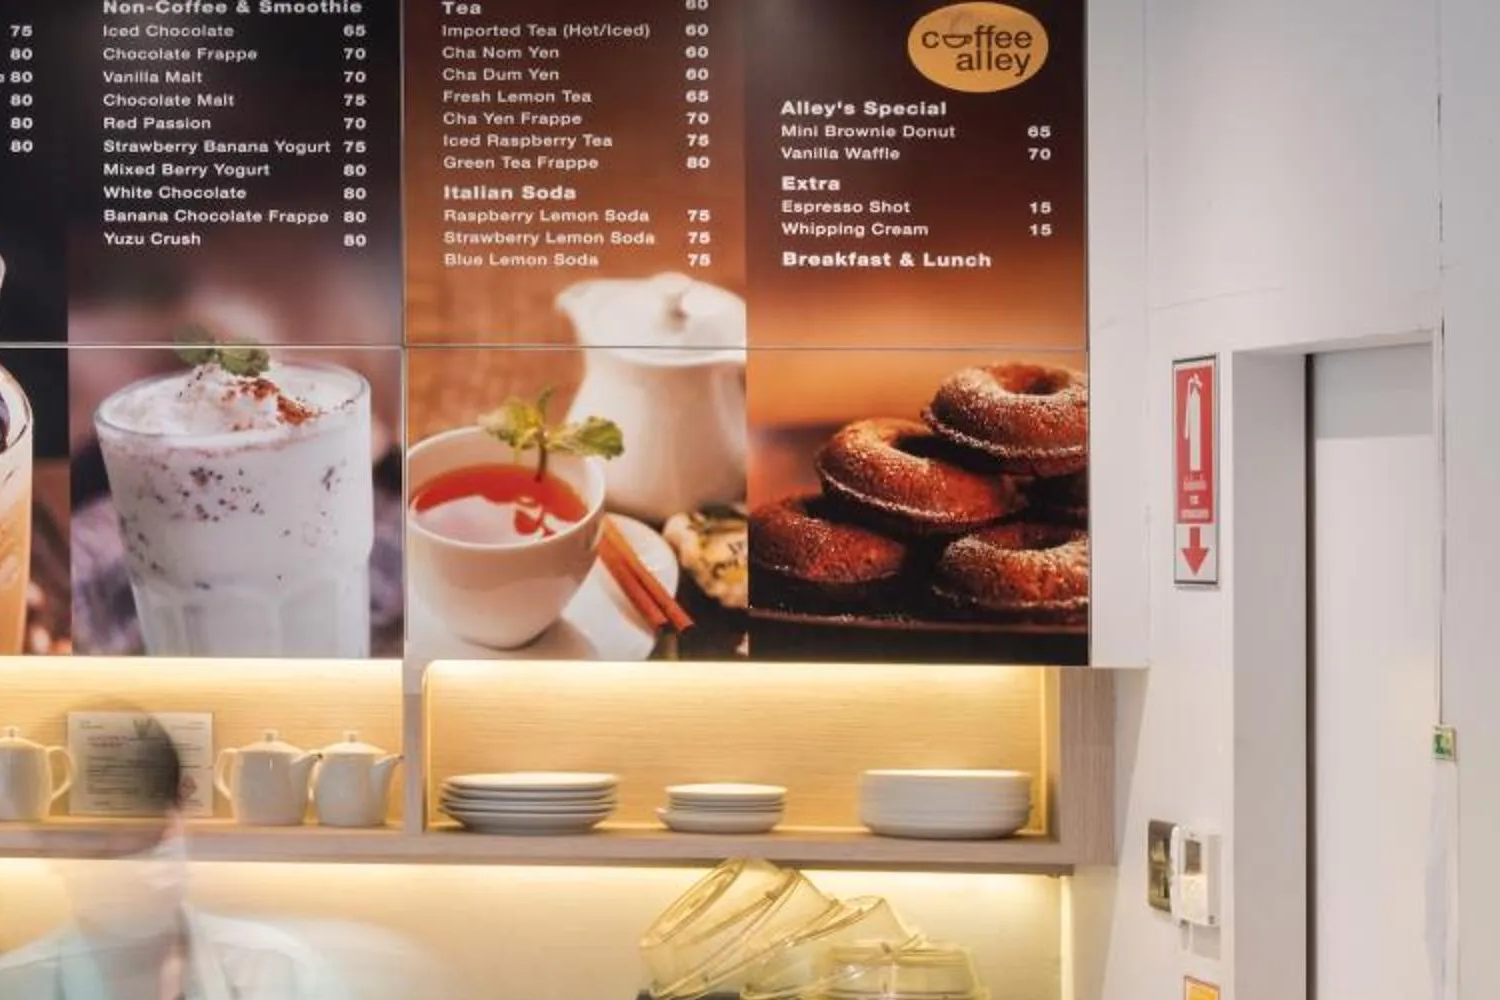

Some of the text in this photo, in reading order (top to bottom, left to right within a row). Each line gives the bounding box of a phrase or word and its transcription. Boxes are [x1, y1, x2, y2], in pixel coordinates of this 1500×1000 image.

[104, 0, 363, 14] Non-Coffee & Smoothie
[441, 1, 481, 14] Tea
[11, 25, 32, 37] 75
[103, 24, 366, 37] Iced Chocolate 65
[442, 24, 650, 39] Imported Tea (Hot/Iced)
[442, 46, 559, 59] Cha Nom Yen
[956, 49, 1031, 76] alley
[103, 71, 366, 83] Vanilla Malt 70
[442, 68, 559, 80] Cha Dum Yen
[103, 94, 234, 106] Chocolate Malt
[444, 90, 592, 102] Fresh Lemon Tea
[781, 101, 946, 118] Alley's Special
[11, 117, 33, 129] 80
[104, 117, 366, 130] Red Passion 70
[444, 112, 709, 126] Cha Yen Frappe 70
[782, 125, 1051, 138] Mini Brownie Donut 65
[10, 140, 33, 152] 80
[104, 140, 366, 155] Strawberry Banana Yogurt 75
[444, 134, 612, 149] Iced Raspberry Tea
[781, 147, 1051, 160] Vanilla Waffle 70
[104, 163, 269, 178] Mixed Berry Yogurt
[782, 176, 840, 191] Extra
[104, 186, 246, 199] White Chocolate
[444, 185, 576, 200] Italian Soda
[782, 200, 1051, 214] Espresso Shot 15
[104, 209, 328, 224] Banana Chocolate Frappe
[444, 209, 710, 224] Raspberry Lemon Soda 75
[782, 222, 1052, 238] Whipping Cream 15
[104, 232, 200, 245] Yuzu Crush
[445, 253, 598, 266] Blue Lemon Soda
[783, 252, 991, 267] Breakfast & Lunch
